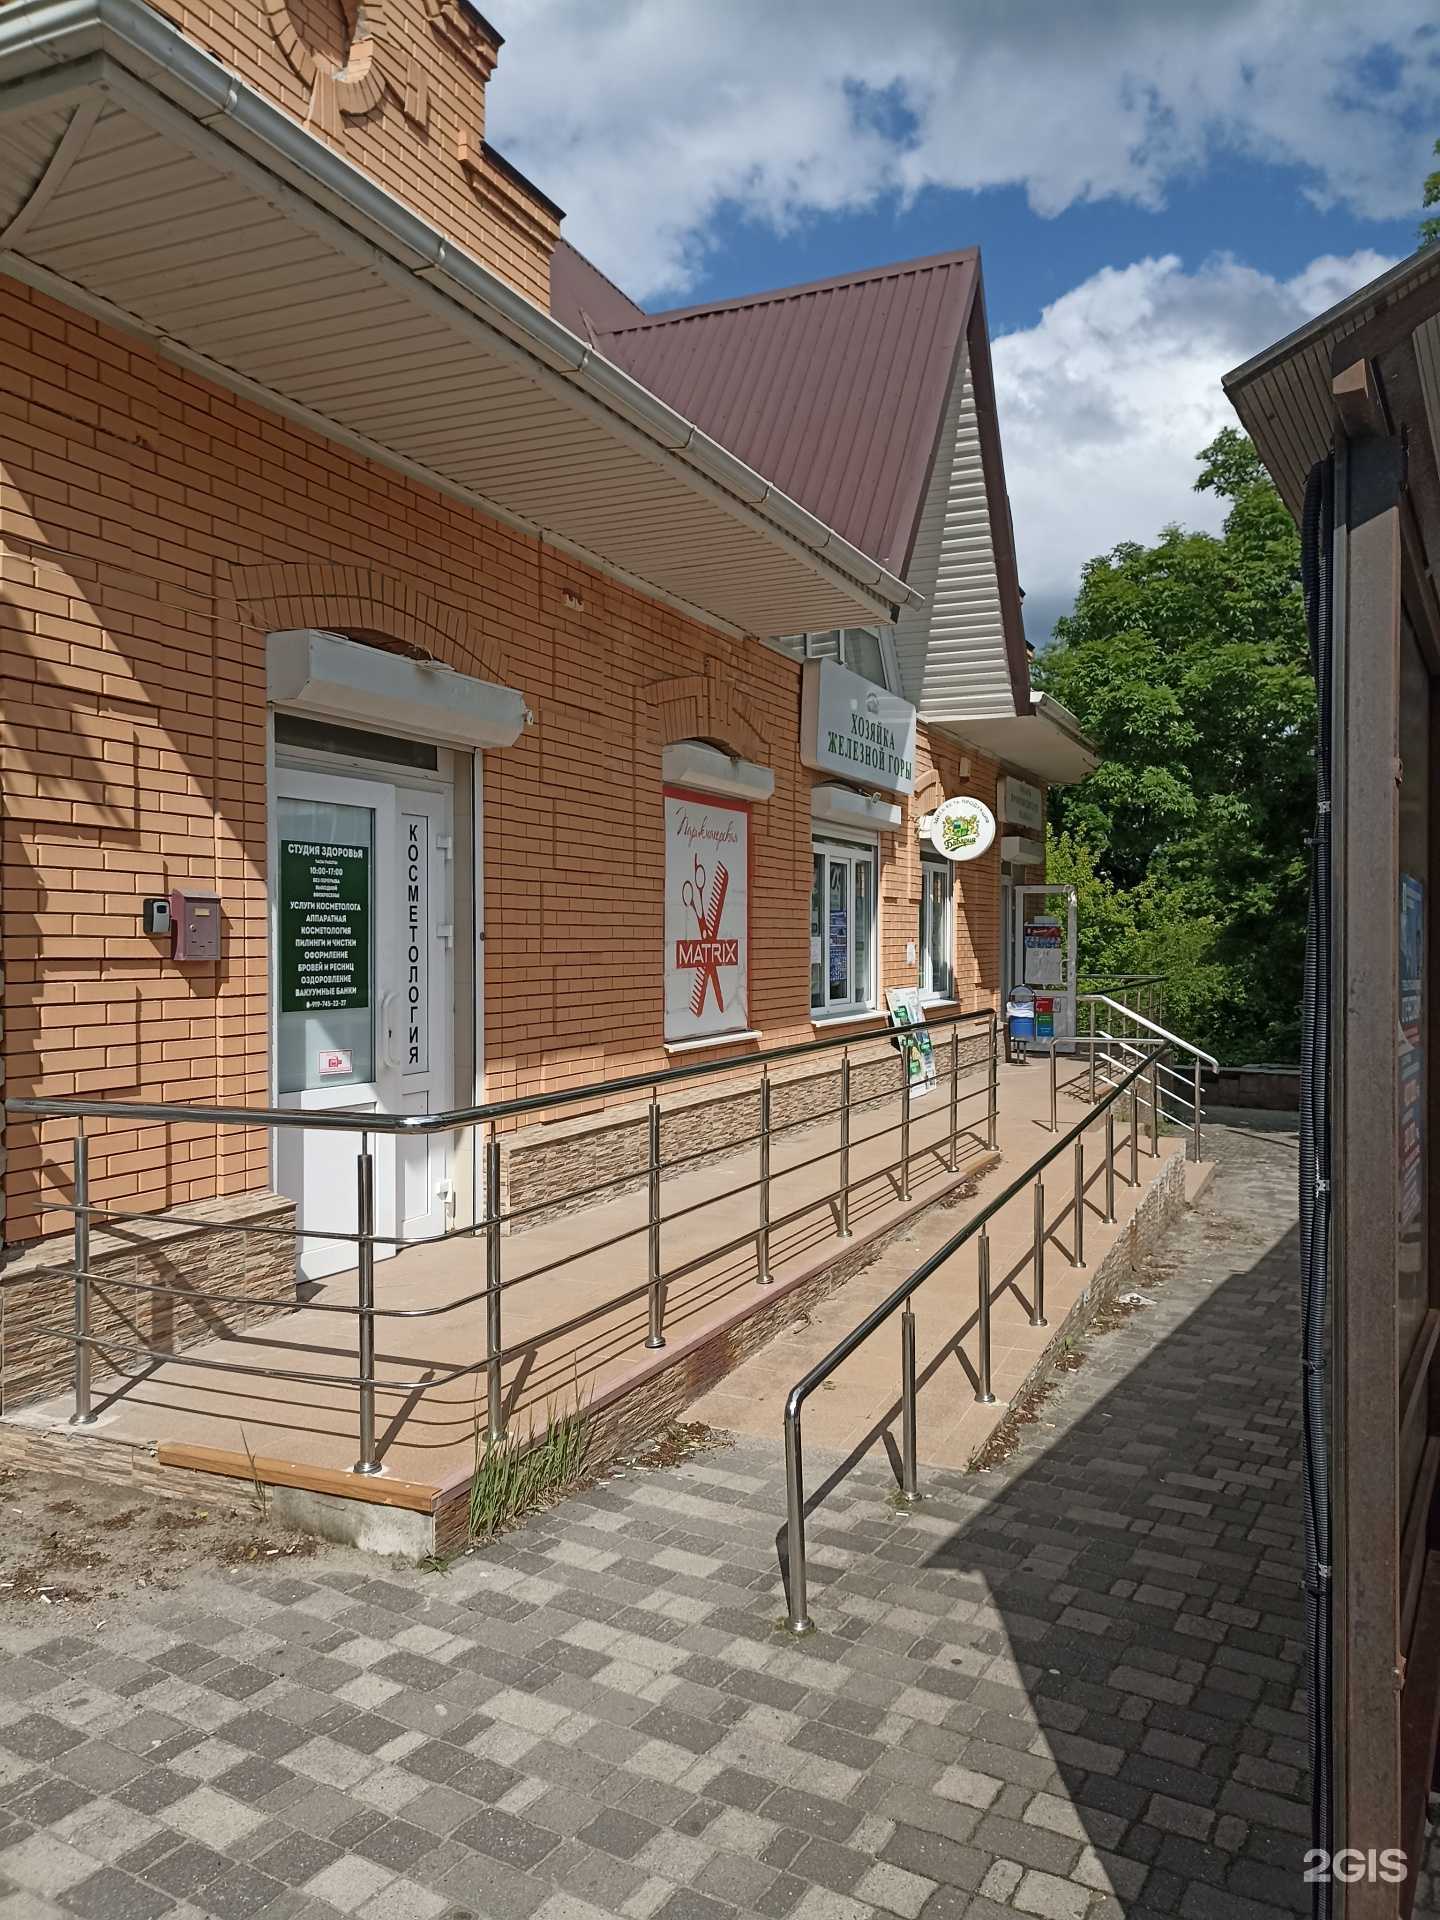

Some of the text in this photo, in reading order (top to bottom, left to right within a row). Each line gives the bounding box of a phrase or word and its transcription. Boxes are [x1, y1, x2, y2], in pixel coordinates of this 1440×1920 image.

[851, 713, 895, 750] ХОЗЯЙКА
[828, 731, 912, 780] ЖЕЛЕЗНОЙ ГОРЫ
[288, 843, 363, 859] СТУДИЯ ЗДОРОВЬЯ
[290, 901, 362, 911] УСЛУГИ КОСМЕТОЛОГА
[305, 914, 347, 923] АППАРАТНАЯ
[300, 926, 352, 935] КОСМЕТОЛОГИЯ
[295, 938, 357, 947] ПИЛИНГИ И ЧИСТКИ
[408, 824, 419, 1064] КОСМЕТОЛОГИЯ
[304, 950, 349, 959] ОФОРМЛЕНИЕ
[679, 943, 737, 964] MATRIX
[298, 962, 355, 972] БРОВЕЙ И РЕСНИЦ
[300, 974, 352, 985] ОЗДОРОВЛЕНИЕ
[295, 986, 357, 997] ВАКУУМНЫЕ БАНКИ
